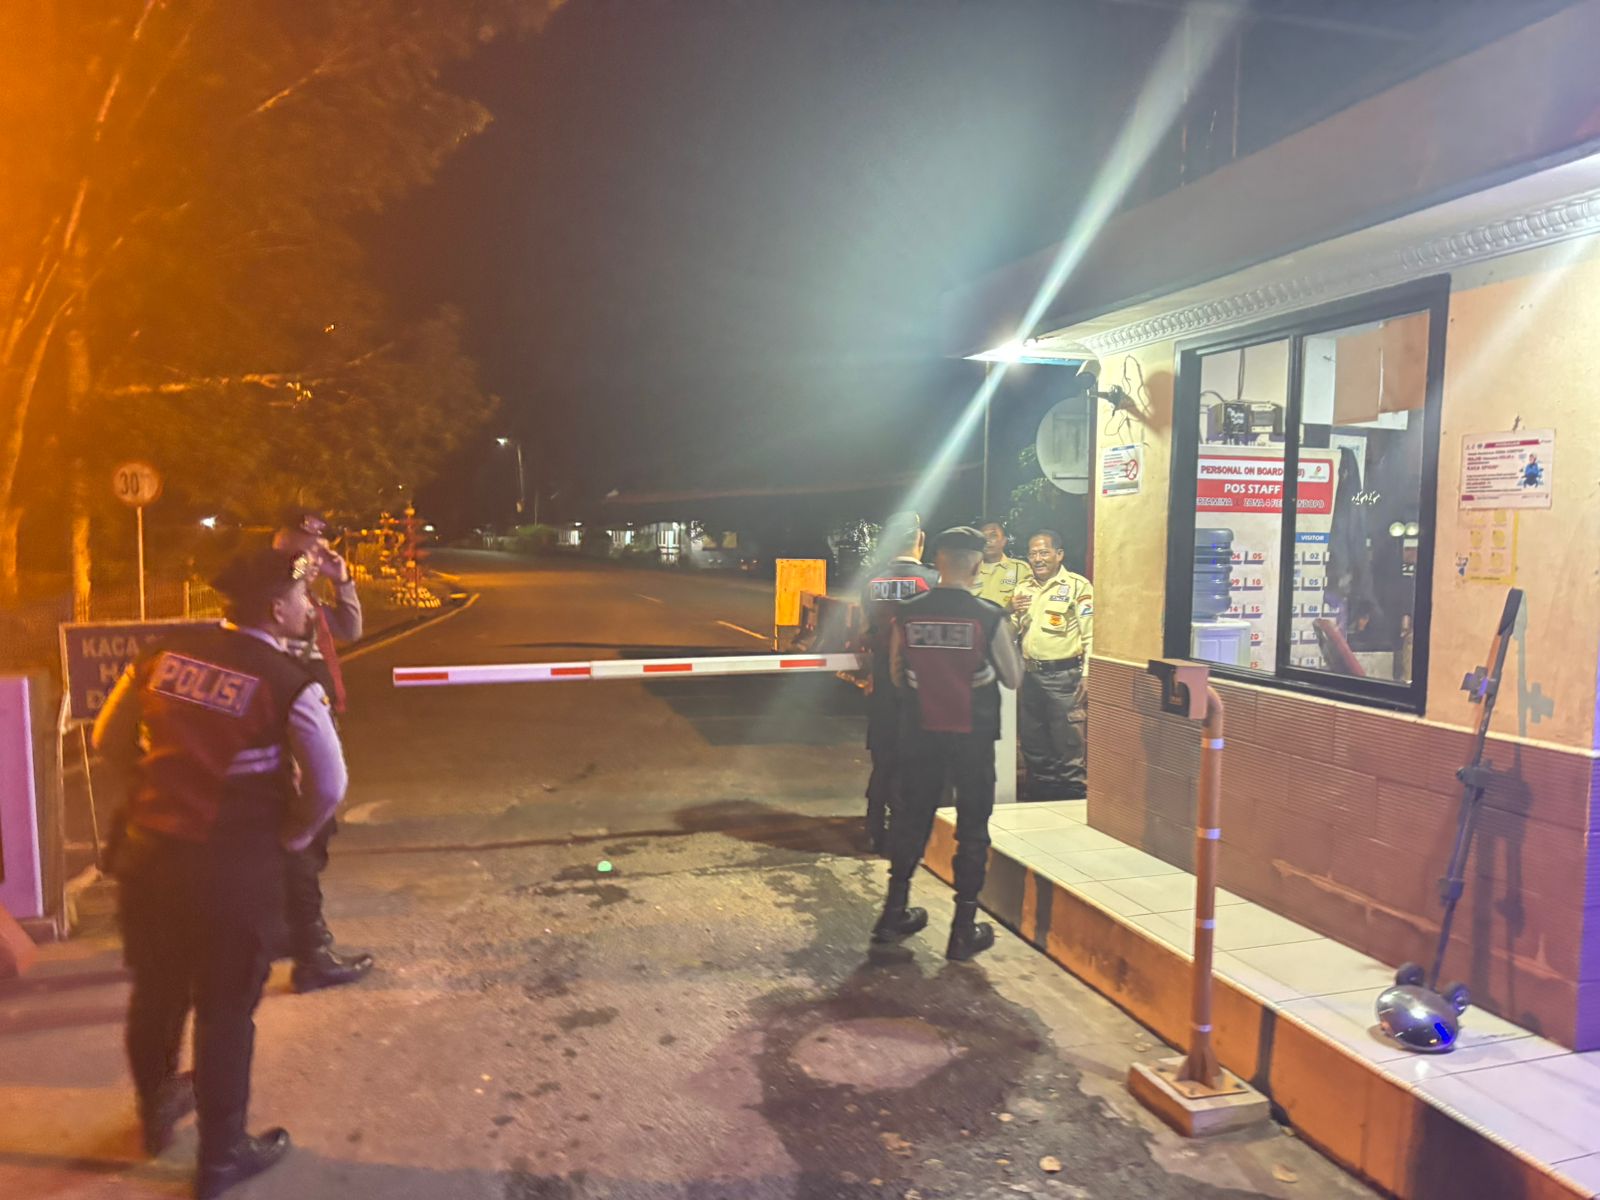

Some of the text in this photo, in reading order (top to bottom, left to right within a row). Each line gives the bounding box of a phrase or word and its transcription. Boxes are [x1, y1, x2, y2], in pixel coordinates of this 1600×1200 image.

[1200, 465, 1284, 476] PERSONAL ON BOARD
[119, 470, 140, 496] 30
[1224, 483, 1282, 495] POS STAFF
[1297, 500, 1325, 509] NDOPO
[1231, 552, 1319, 560] 04 05 02
[1251, 578, 1261, 586] 10
[1250, 605, 1260, 613] 15
[1308, 605, 1318, 613] 08
[1250, 633, 1259, 641] 20
[82, 635, 140, 657] KACA
